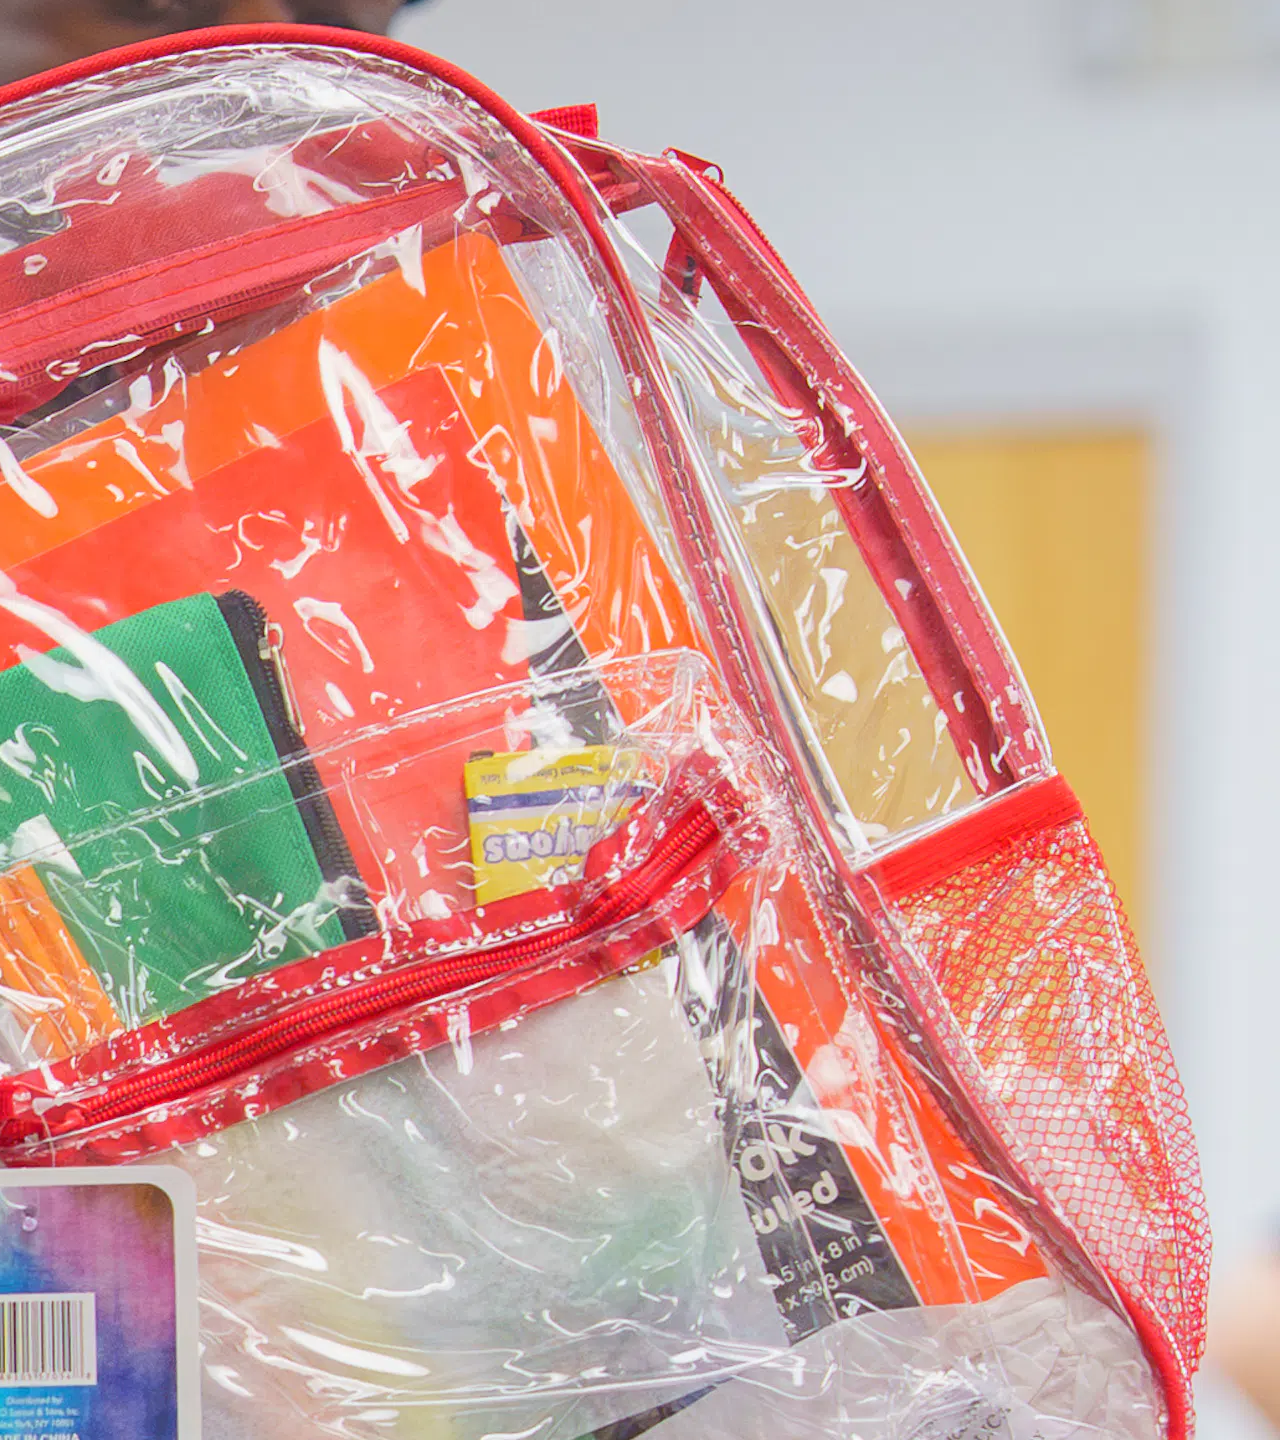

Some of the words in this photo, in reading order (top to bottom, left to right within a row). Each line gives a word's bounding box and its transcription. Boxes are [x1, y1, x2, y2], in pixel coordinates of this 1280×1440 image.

[827, 1241, 843, 1259] 8
[841, 1235, 863, 1253] in
[840, 1255, 875, 1283] cm)
